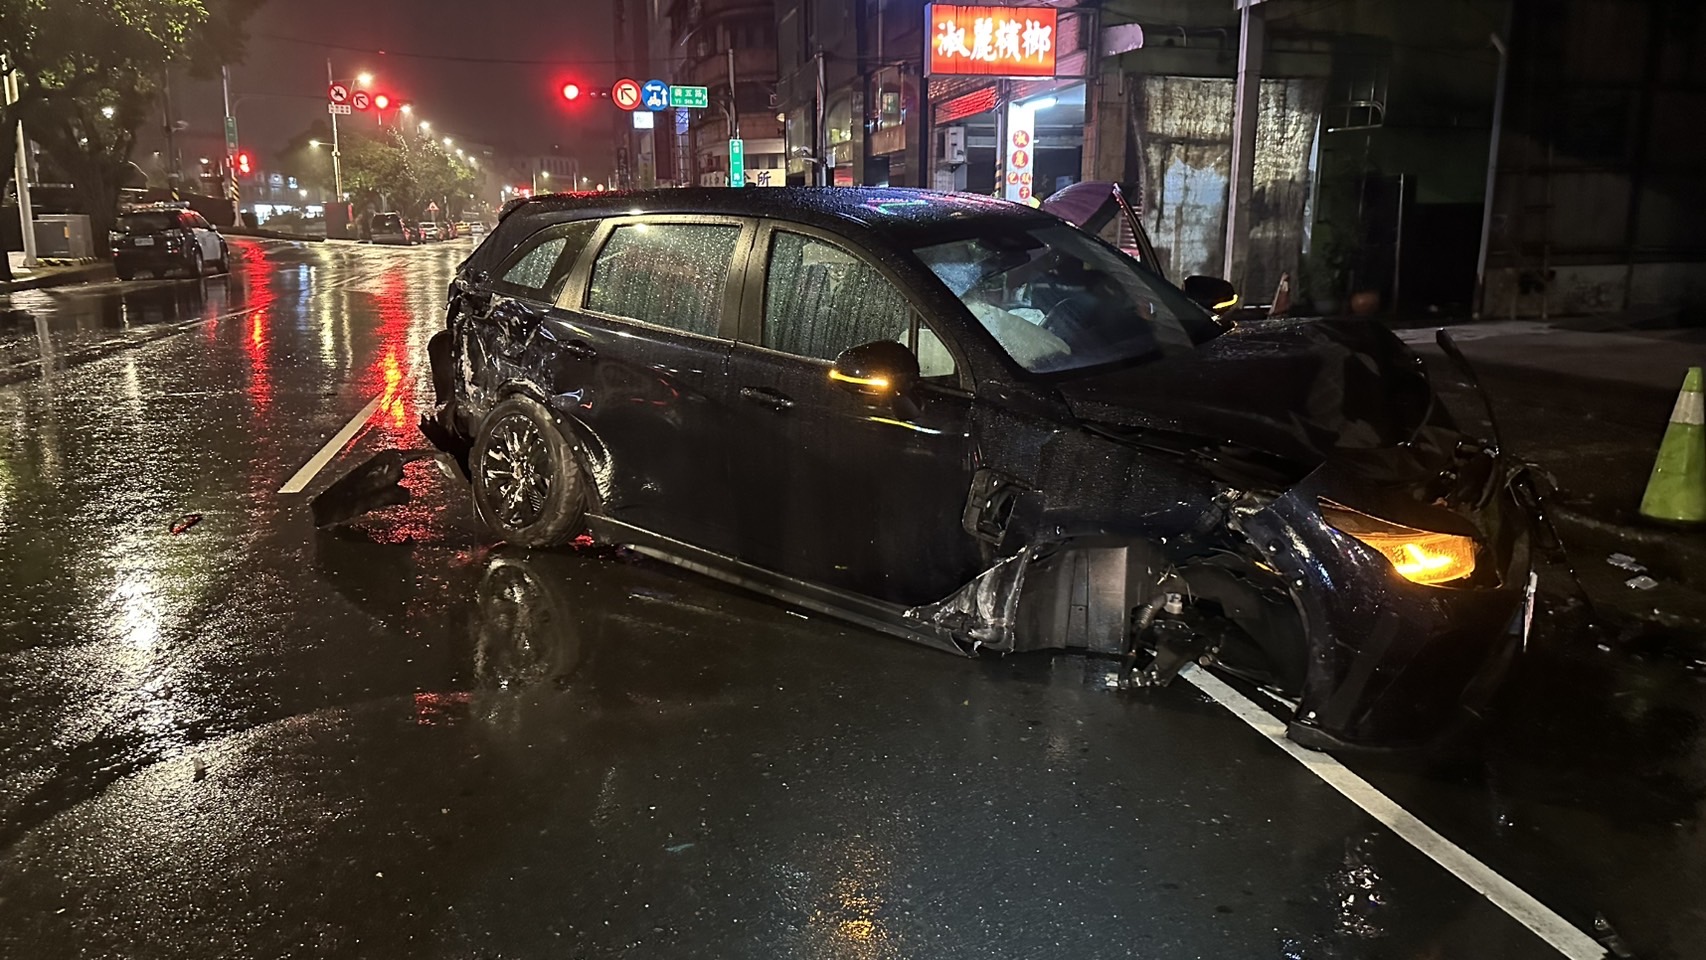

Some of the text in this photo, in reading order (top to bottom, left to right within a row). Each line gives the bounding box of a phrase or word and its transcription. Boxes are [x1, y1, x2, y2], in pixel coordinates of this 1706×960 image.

[936, 16, 1052, 63] 淑麗檳榔
[1013, 130, 1028, 168] 淑麗
